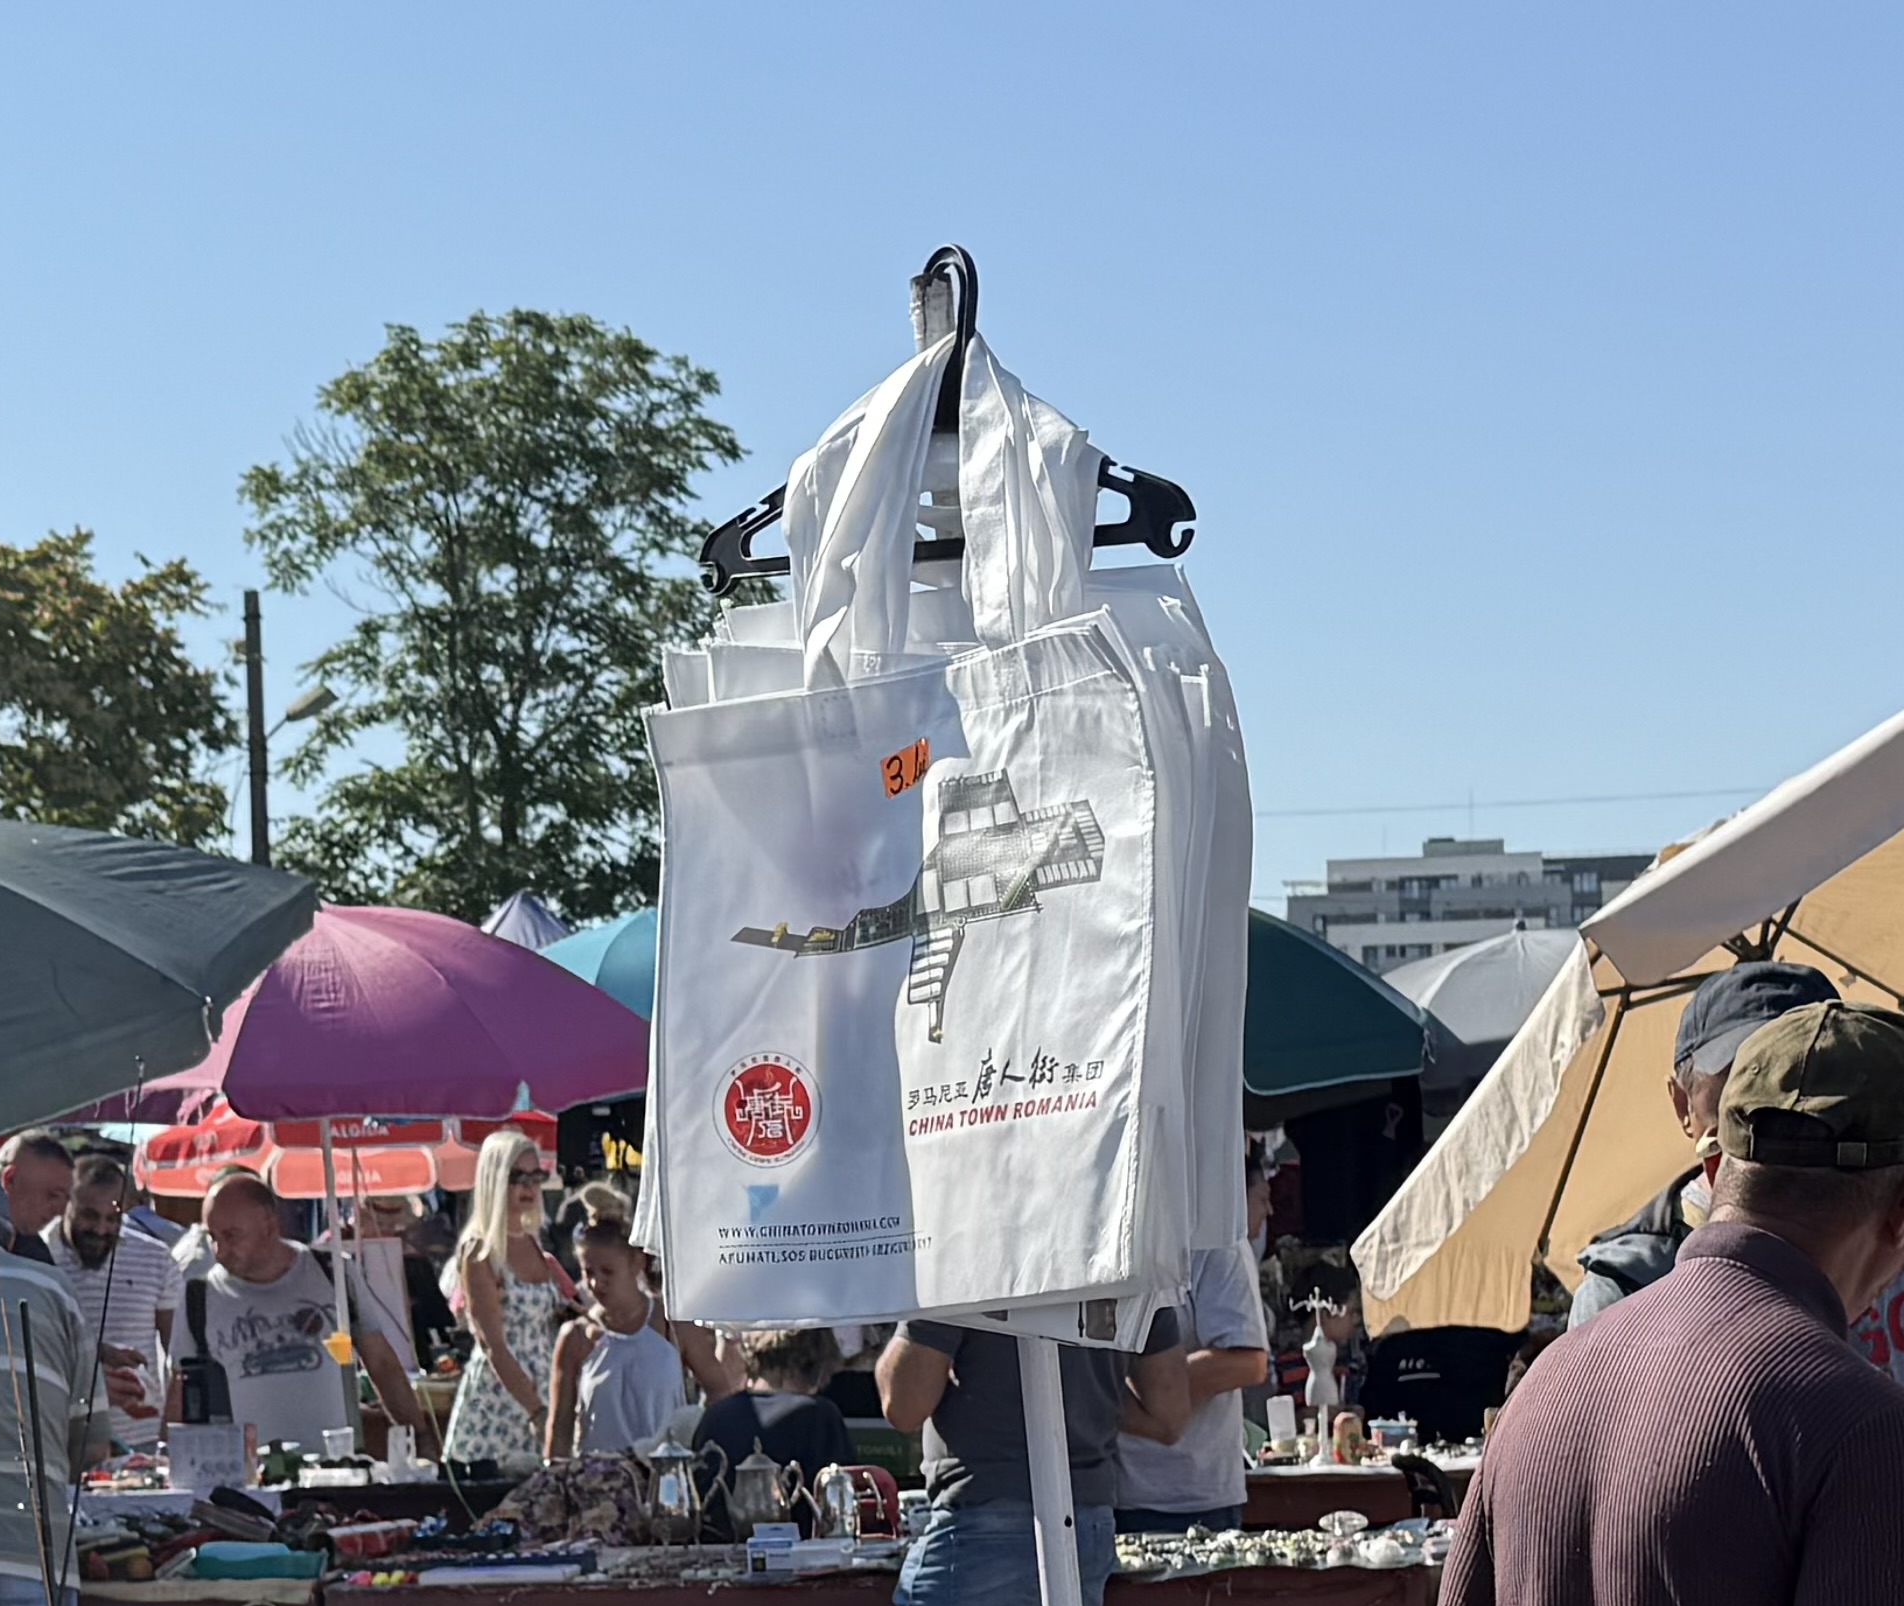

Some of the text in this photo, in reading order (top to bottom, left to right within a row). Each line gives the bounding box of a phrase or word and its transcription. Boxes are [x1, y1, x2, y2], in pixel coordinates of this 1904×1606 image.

[909, 1091, 1098, 1136] CHINA TOWN ROMANIA
